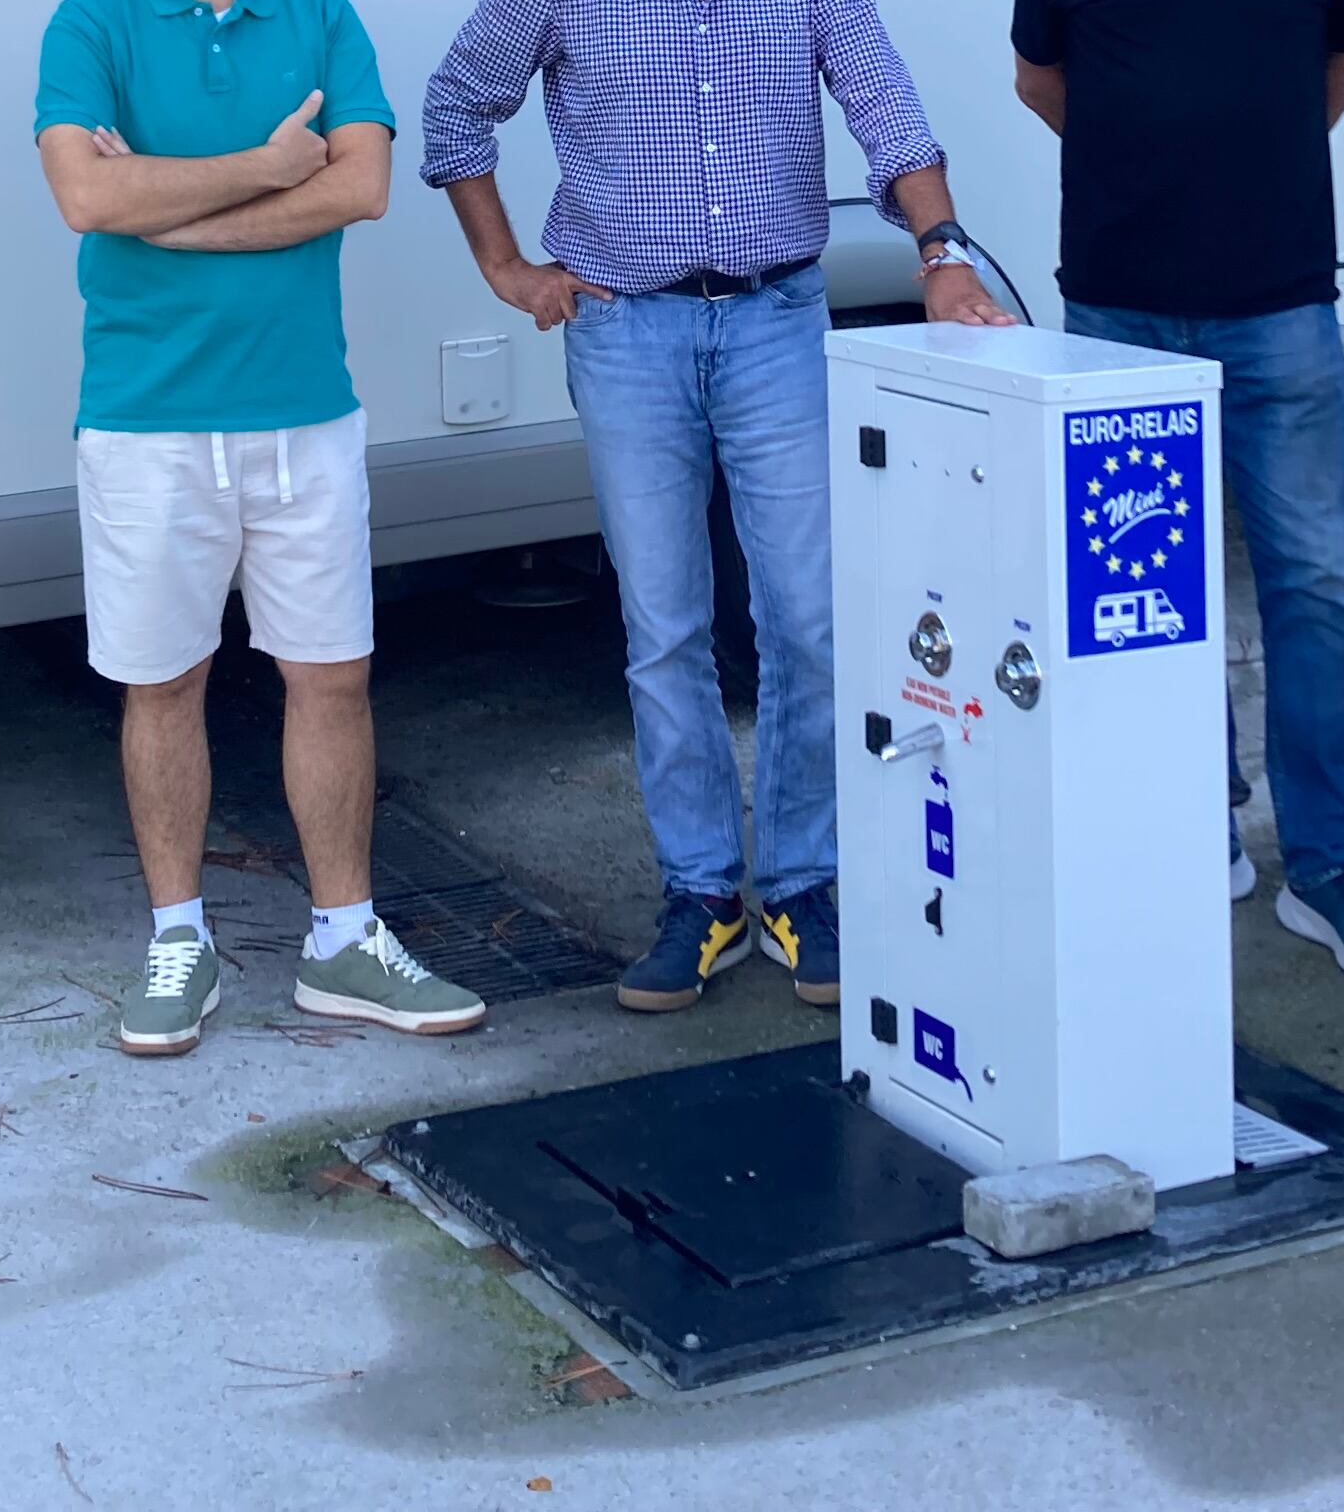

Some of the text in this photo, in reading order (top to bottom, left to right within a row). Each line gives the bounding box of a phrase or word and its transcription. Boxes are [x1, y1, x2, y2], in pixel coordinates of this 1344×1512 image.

[1069, 407, 1198, 445] EURO-RELAIS
[1102, 481, 1165, 527] Mini
[930, 829, 950, 856] WC
[922, 1030, 943, 1061] WC
